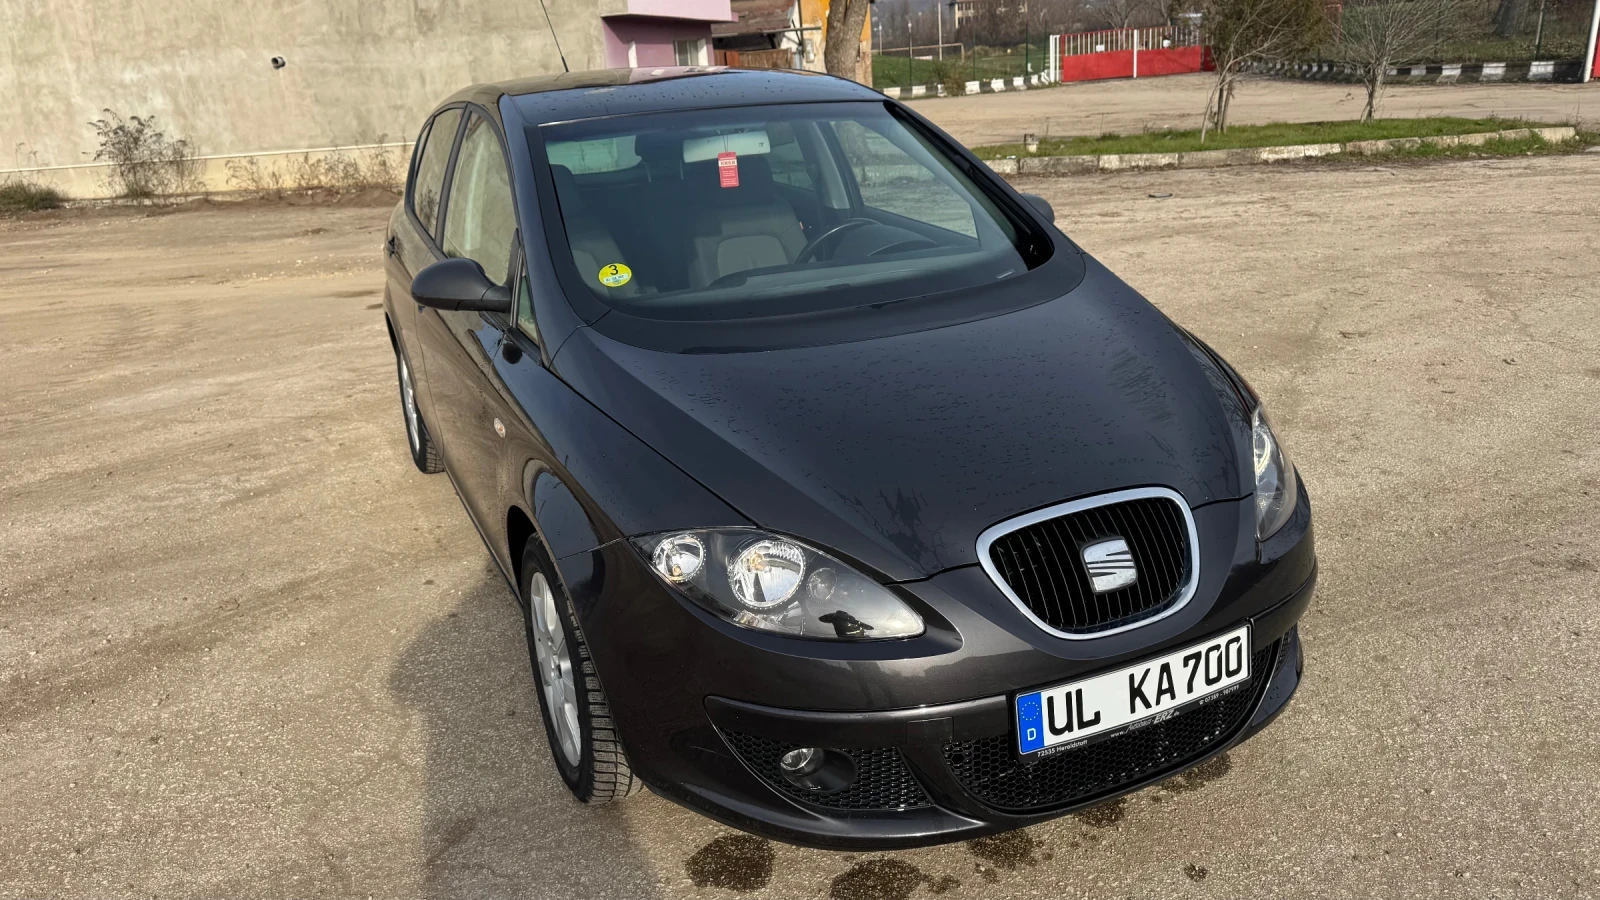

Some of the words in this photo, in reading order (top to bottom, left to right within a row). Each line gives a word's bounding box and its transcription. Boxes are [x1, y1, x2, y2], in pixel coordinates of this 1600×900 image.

[608, 264, 619, 276] 3
[1046, 688, 1101, 736] UL
[1026, 728, 1037, 741] D
[1037, 747, 1056, 758] 72535
